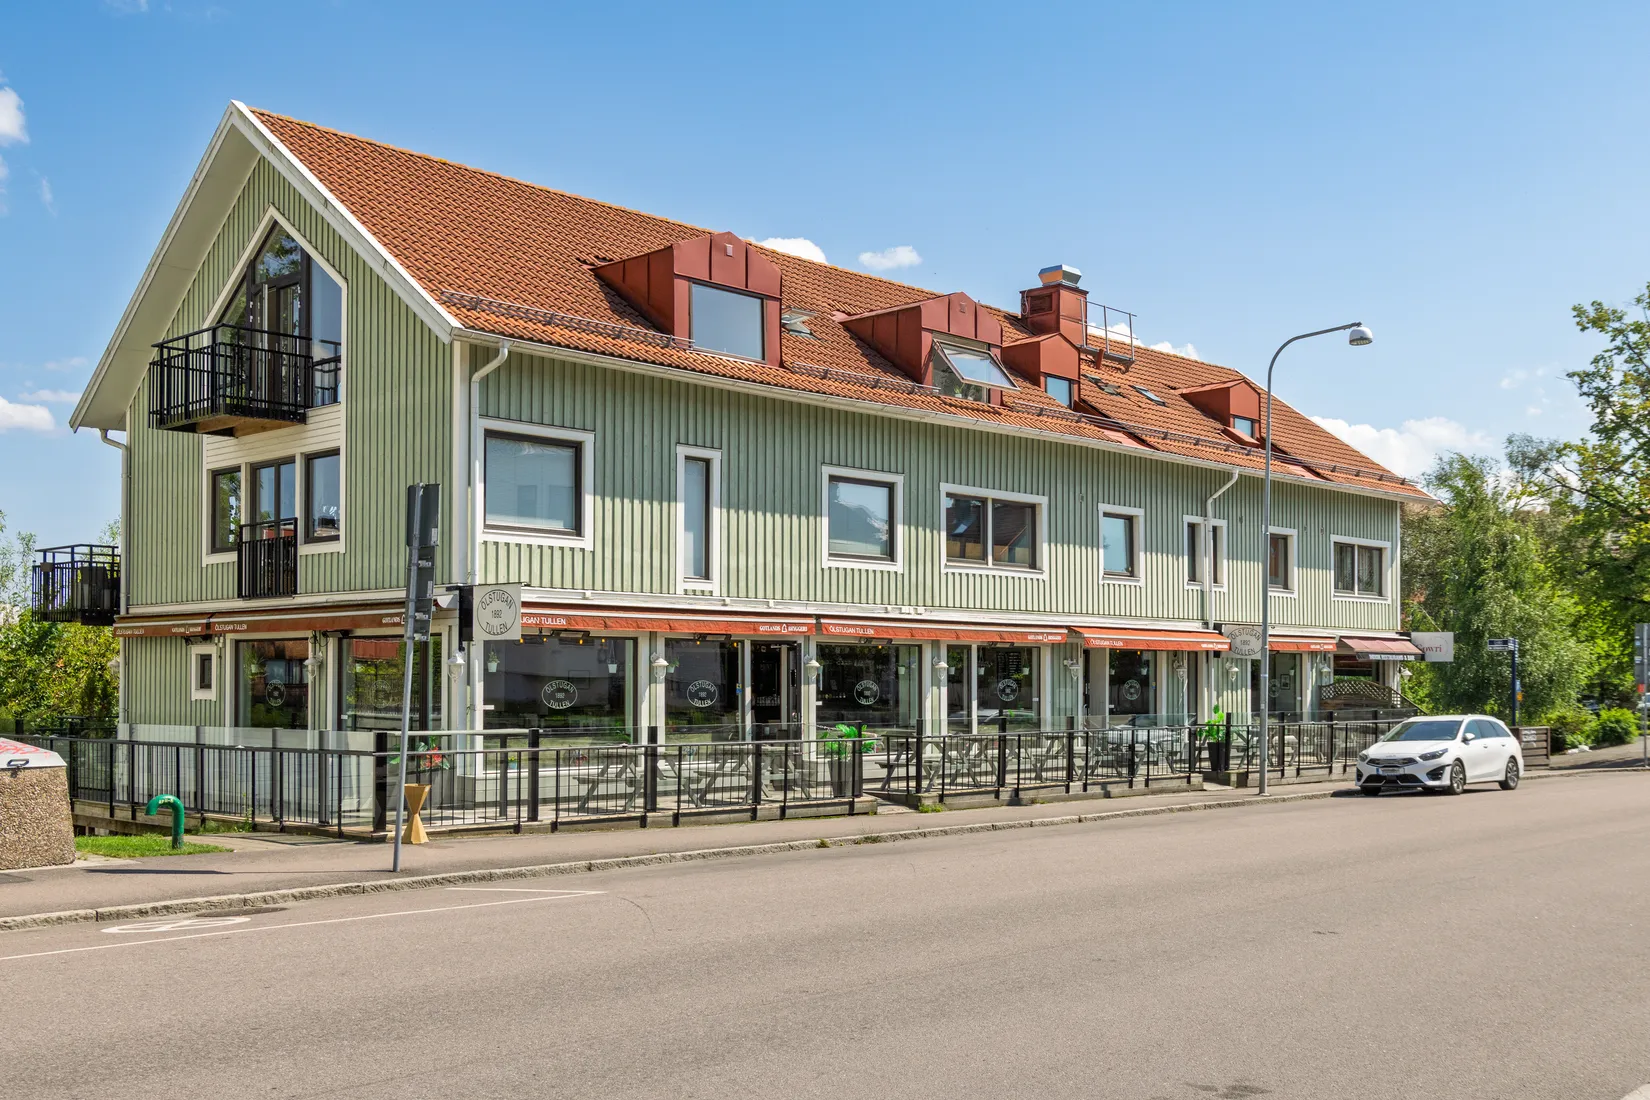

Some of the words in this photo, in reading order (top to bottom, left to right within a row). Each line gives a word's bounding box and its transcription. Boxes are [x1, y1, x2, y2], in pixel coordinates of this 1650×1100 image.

[491, 610, 503, 619] 1892
[521, 616, 540, 624] UGAN
[541, 617, 566, 625] TULLEN
[485, 621, 508, 635] TULLEN
[829, 625, 856, 634] ÖLSTUGAN
[856, 627, 875, 635] TULLEN
[1234, 647, 1256, 656] TULLEN
[549, 700, 571, 709] TULLEN
[693, 699, 712, 707] TULLEN
